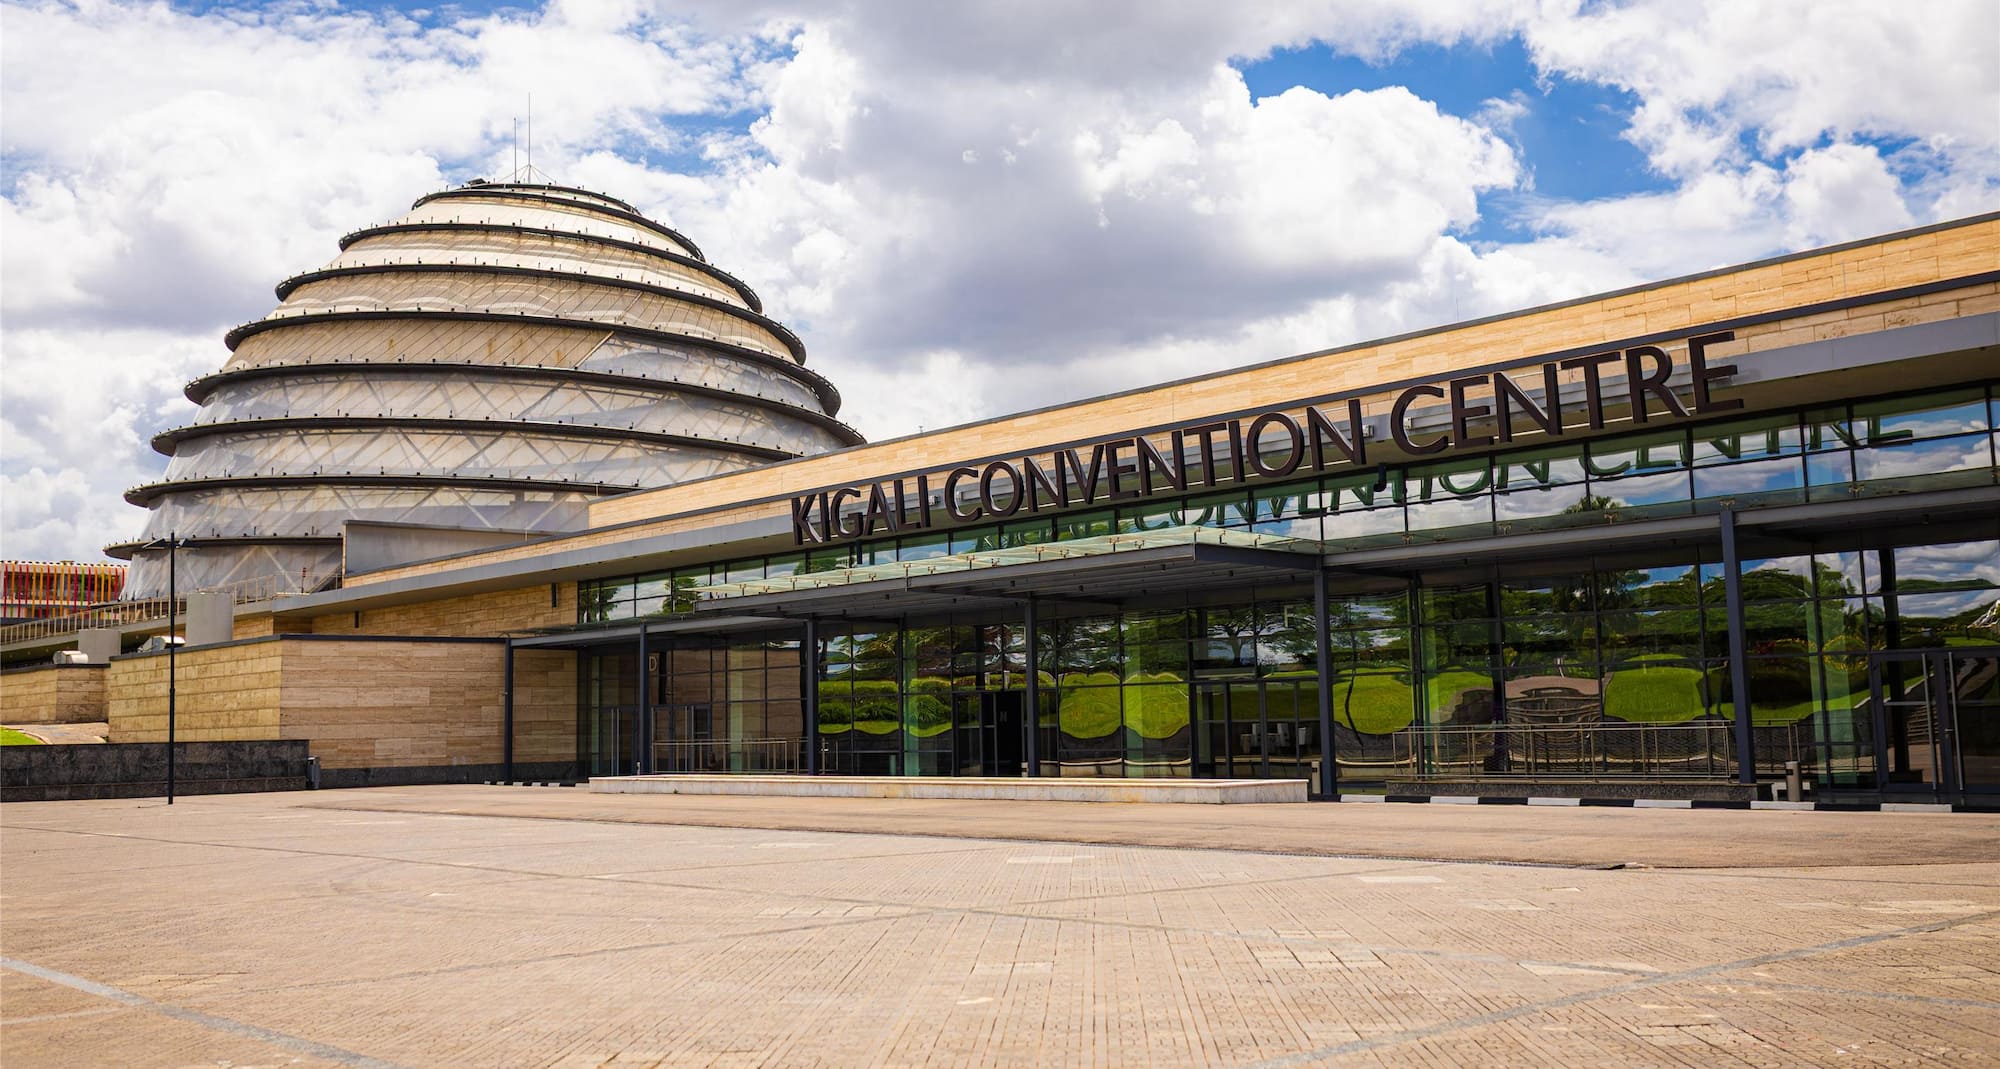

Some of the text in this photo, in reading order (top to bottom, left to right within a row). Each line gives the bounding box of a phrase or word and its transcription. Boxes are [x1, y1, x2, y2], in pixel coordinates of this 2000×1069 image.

[791, 475, 931, 545] KIGALI
[944, 399, 1366, 522] CONVENTION
[1390, 331, 1744, 456] CENTRE
